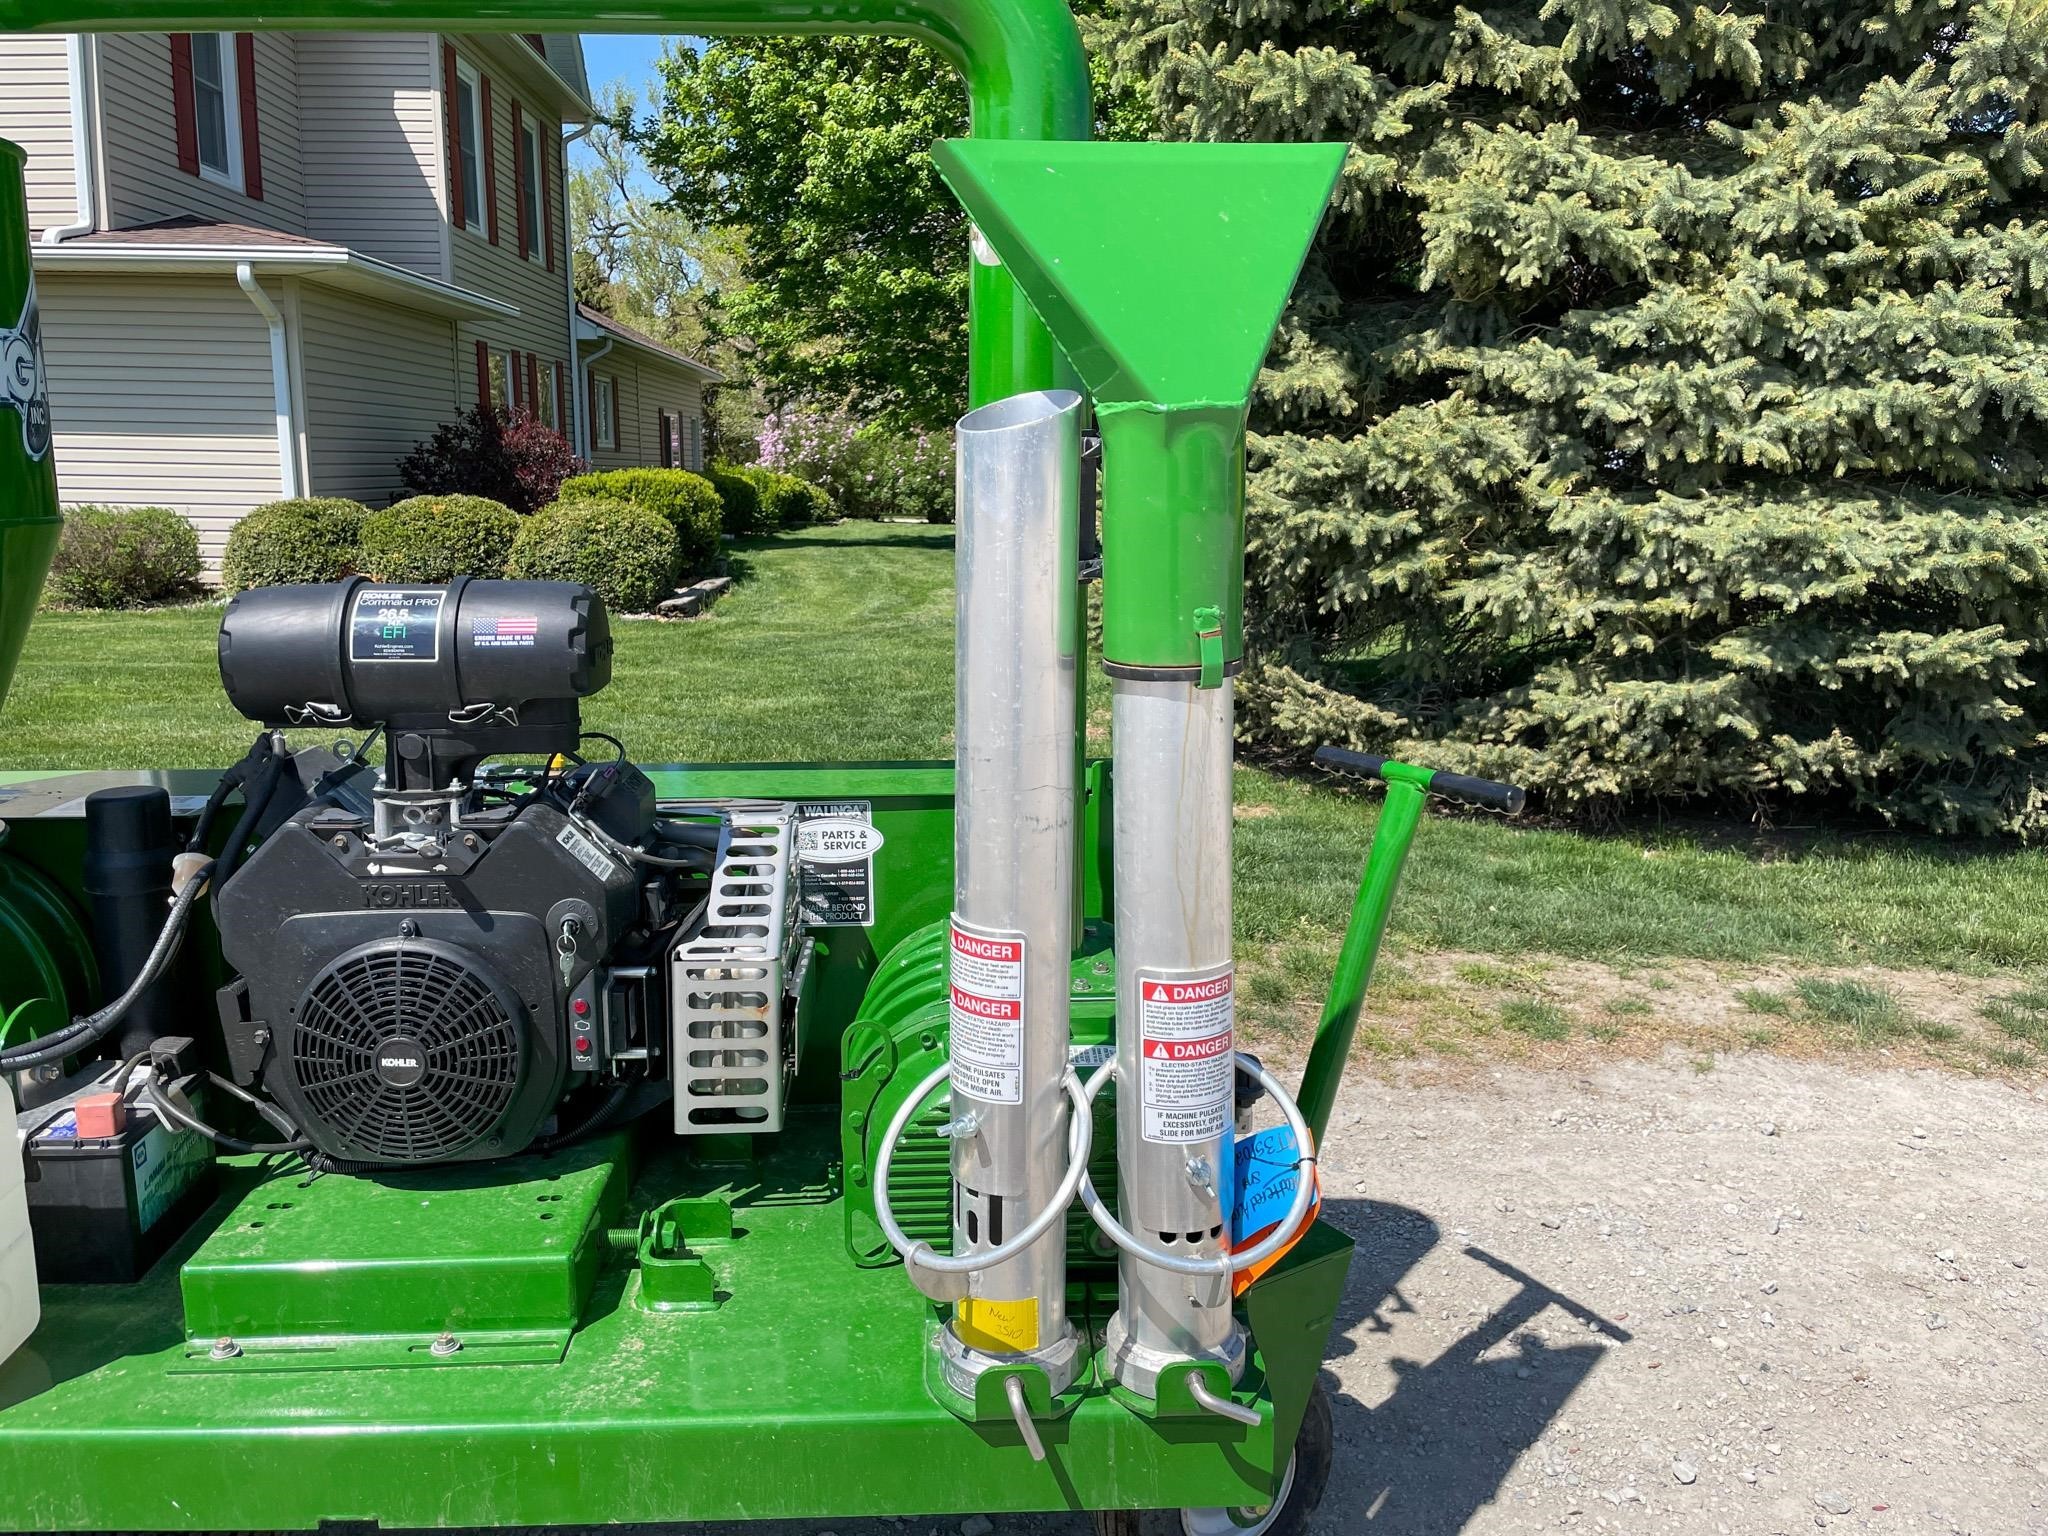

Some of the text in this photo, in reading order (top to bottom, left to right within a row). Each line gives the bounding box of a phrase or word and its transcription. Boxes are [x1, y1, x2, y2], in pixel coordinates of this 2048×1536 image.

[360, 598, 440, 606] Command PRO
[378, 608, 409, 620] 26.5
[383, 626, 406, 639] EFI
[803, 806, 861, 817] WALINGA
[822, 830, 868, 840] PARTS &
[824, 840, 867, 850] SERVICE
[359, 882, 463, 908] KOHLER
[805, 903, 866, 912] VALUE BEYOND
[809, 912, 864, 920] THE PRODUCT
[958, 936, 1012, 958] DANGER
[1173, 979, 1229, 1000] DANGER
[957, 992, 1012, 1016] DANGER
[1174, 1036, 1229, 1058] DANGER
[1161, 1059, 1210, 1068] ELECTRO-STATIC
[974, 1068, 1006, 1080] PULSATES
[971, 1083, 988, 1095] MORE
[982, 1078, 1000, 1088] OPEN
[1166, 1111, 1197, 1119] MACHINE
[1200, 1104, 1226, 1117] PULSATES
[1163, 1114, 1223, 1128] EXCESSIVELY, OPEN
[1160, 1129, 1178, 1137] SLIDE
[1196, 1125, 1214, 1135] MORE
